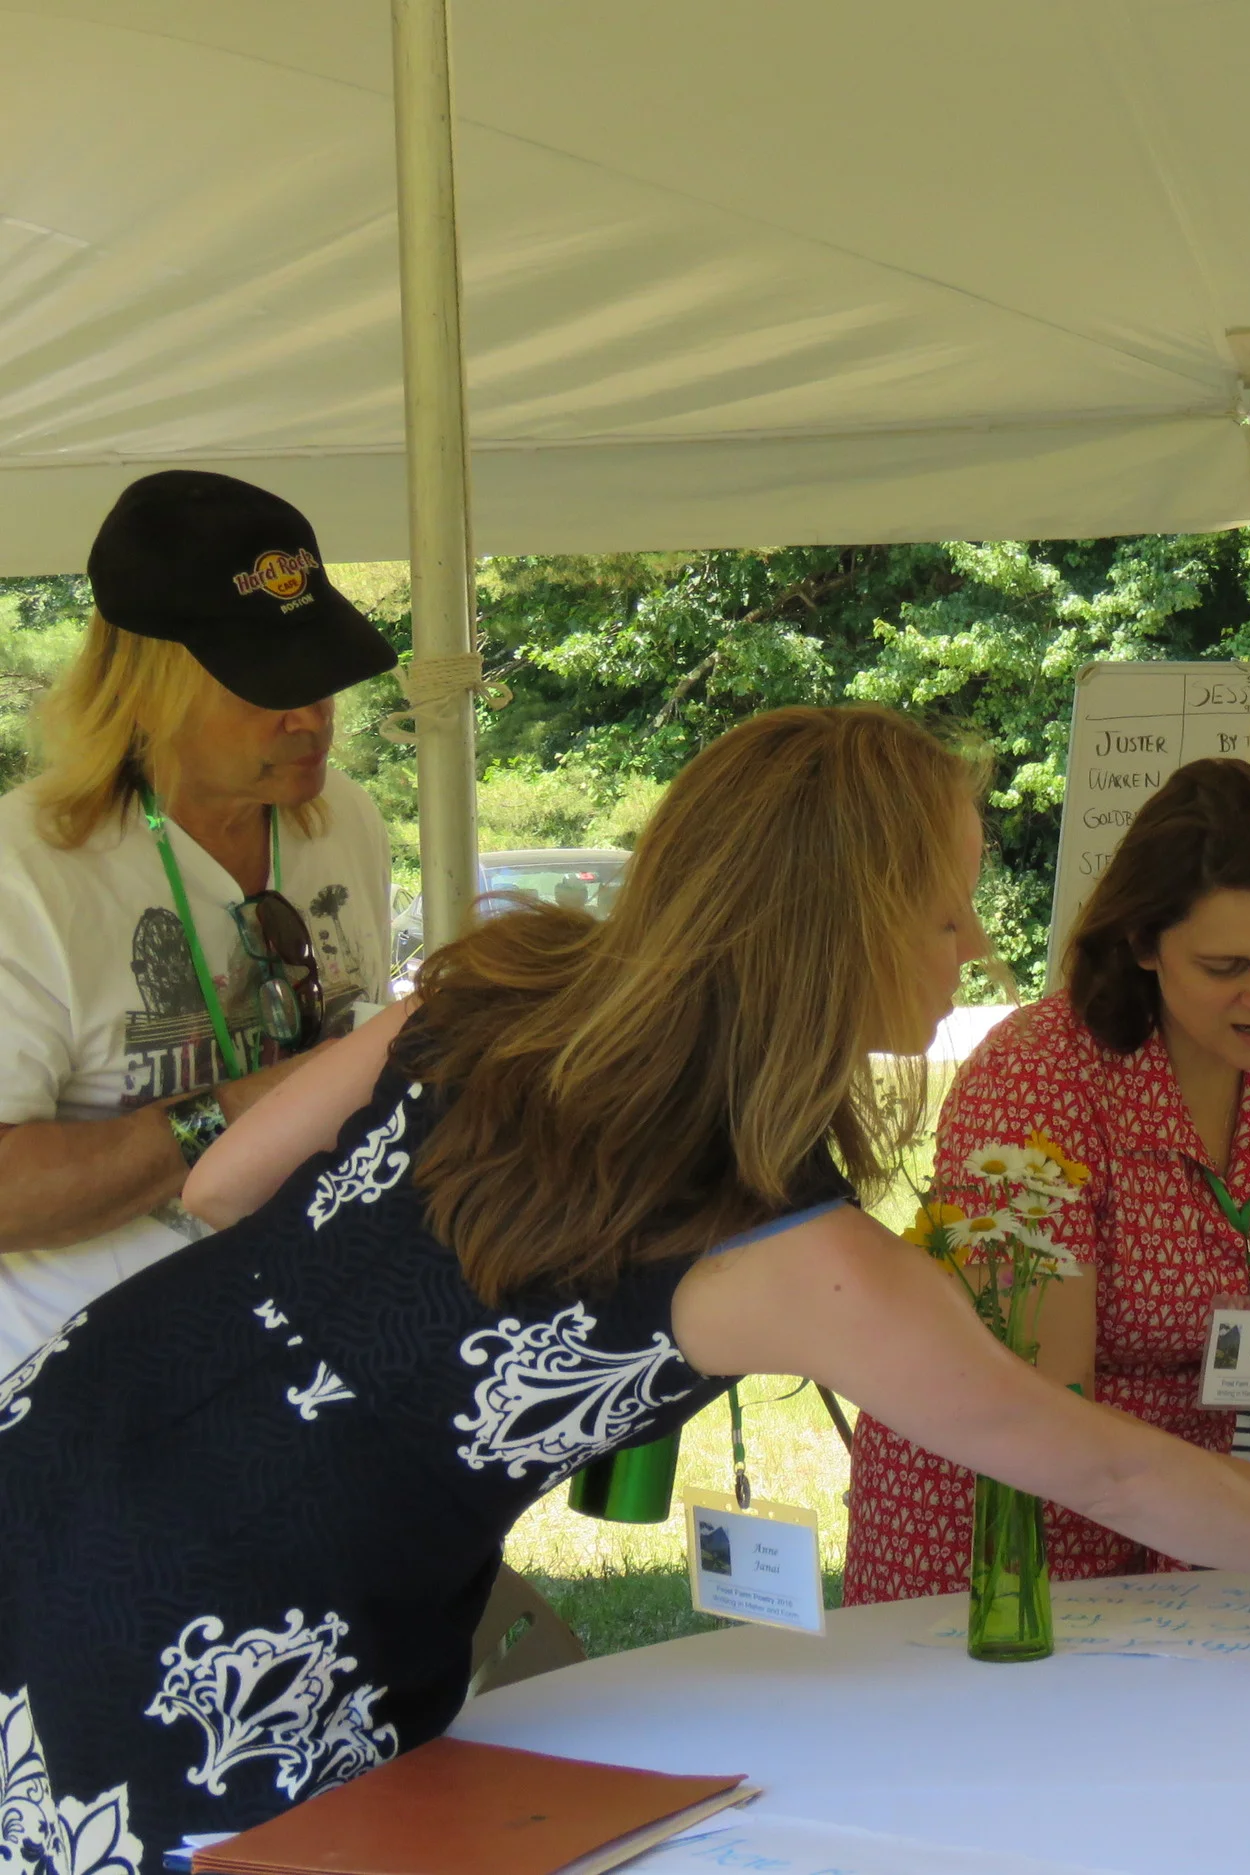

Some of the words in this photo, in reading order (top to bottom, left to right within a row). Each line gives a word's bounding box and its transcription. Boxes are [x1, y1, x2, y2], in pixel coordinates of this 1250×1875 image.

[232, 561, 278, 595] Hard
[277, 548, 319, 576] Rock
[278, 579, 299, 593] CAFE
[280, 593, 315, 615] BOSTON
[1095, 731, 1168, 756] JUSTER
[1217, 731, 1238, 753] BY
[1088, 767, 1160, 791] WARREN
[1083, 807, 1138, 829] GOLDB
[753, 1543, 779, 1557] Anne
